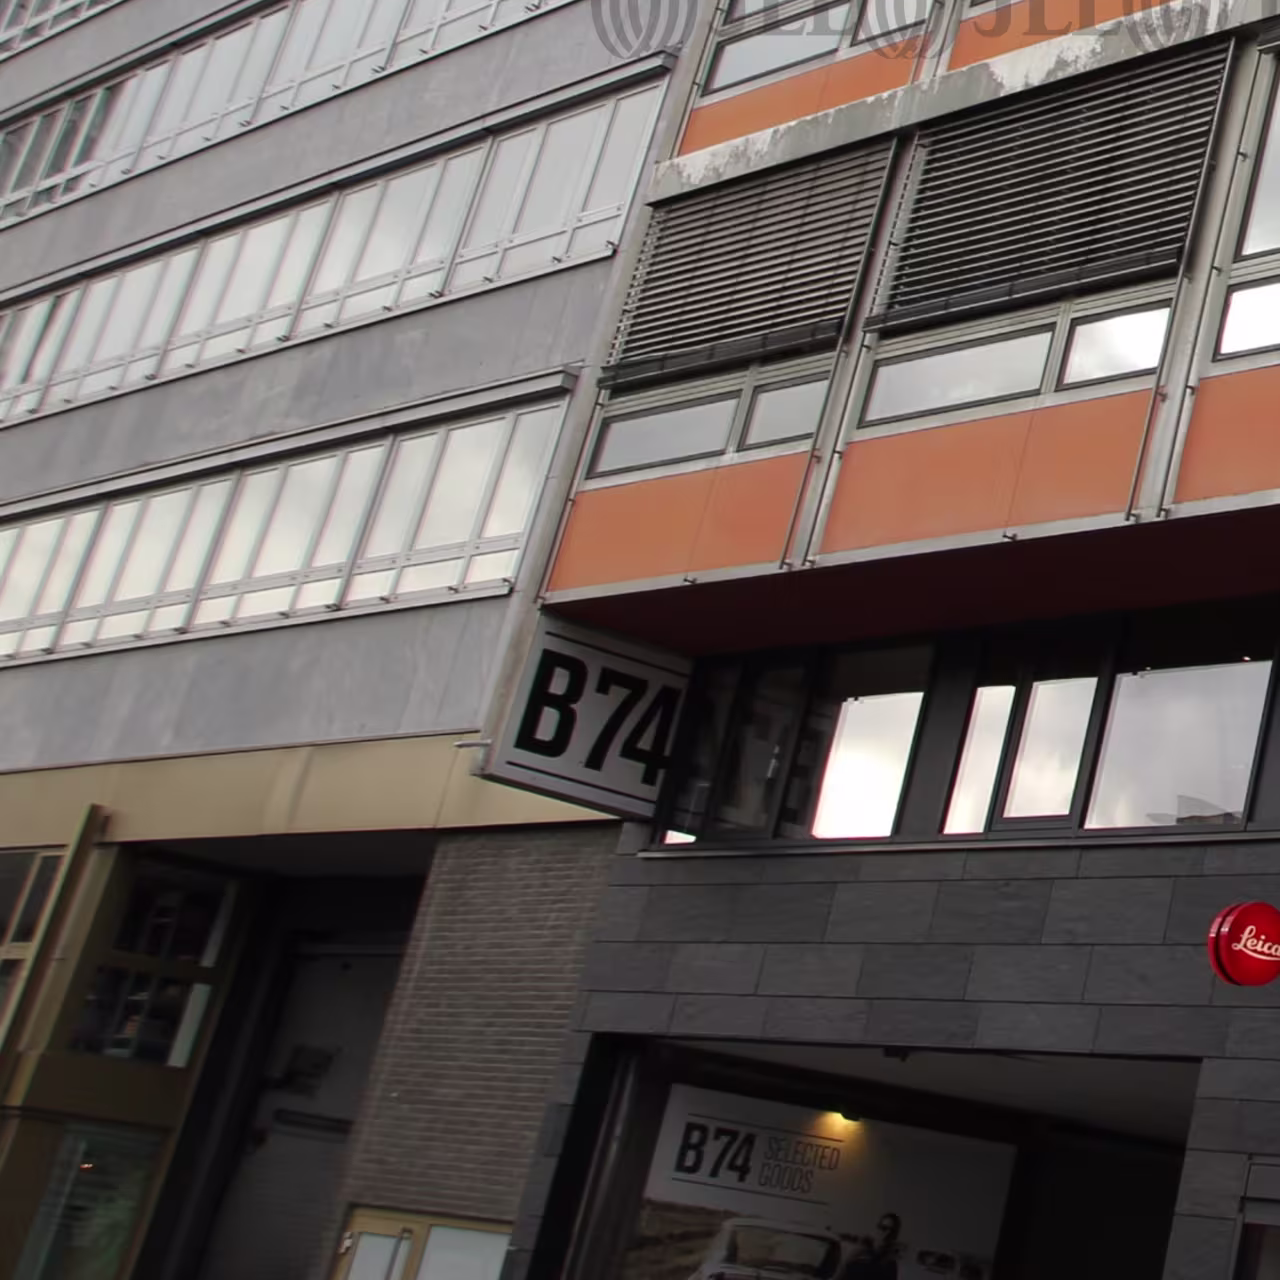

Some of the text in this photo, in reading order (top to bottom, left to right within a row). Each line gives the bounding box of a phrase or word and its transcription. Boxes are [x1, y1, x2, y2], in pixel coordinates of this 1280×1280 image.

[513, 648, 683, 787] B74
[674, 1122, 756, 1183] B74
[763, 1135, 841, 1171] SELECTED
[757, 1160, 814, 1194] GOODS
